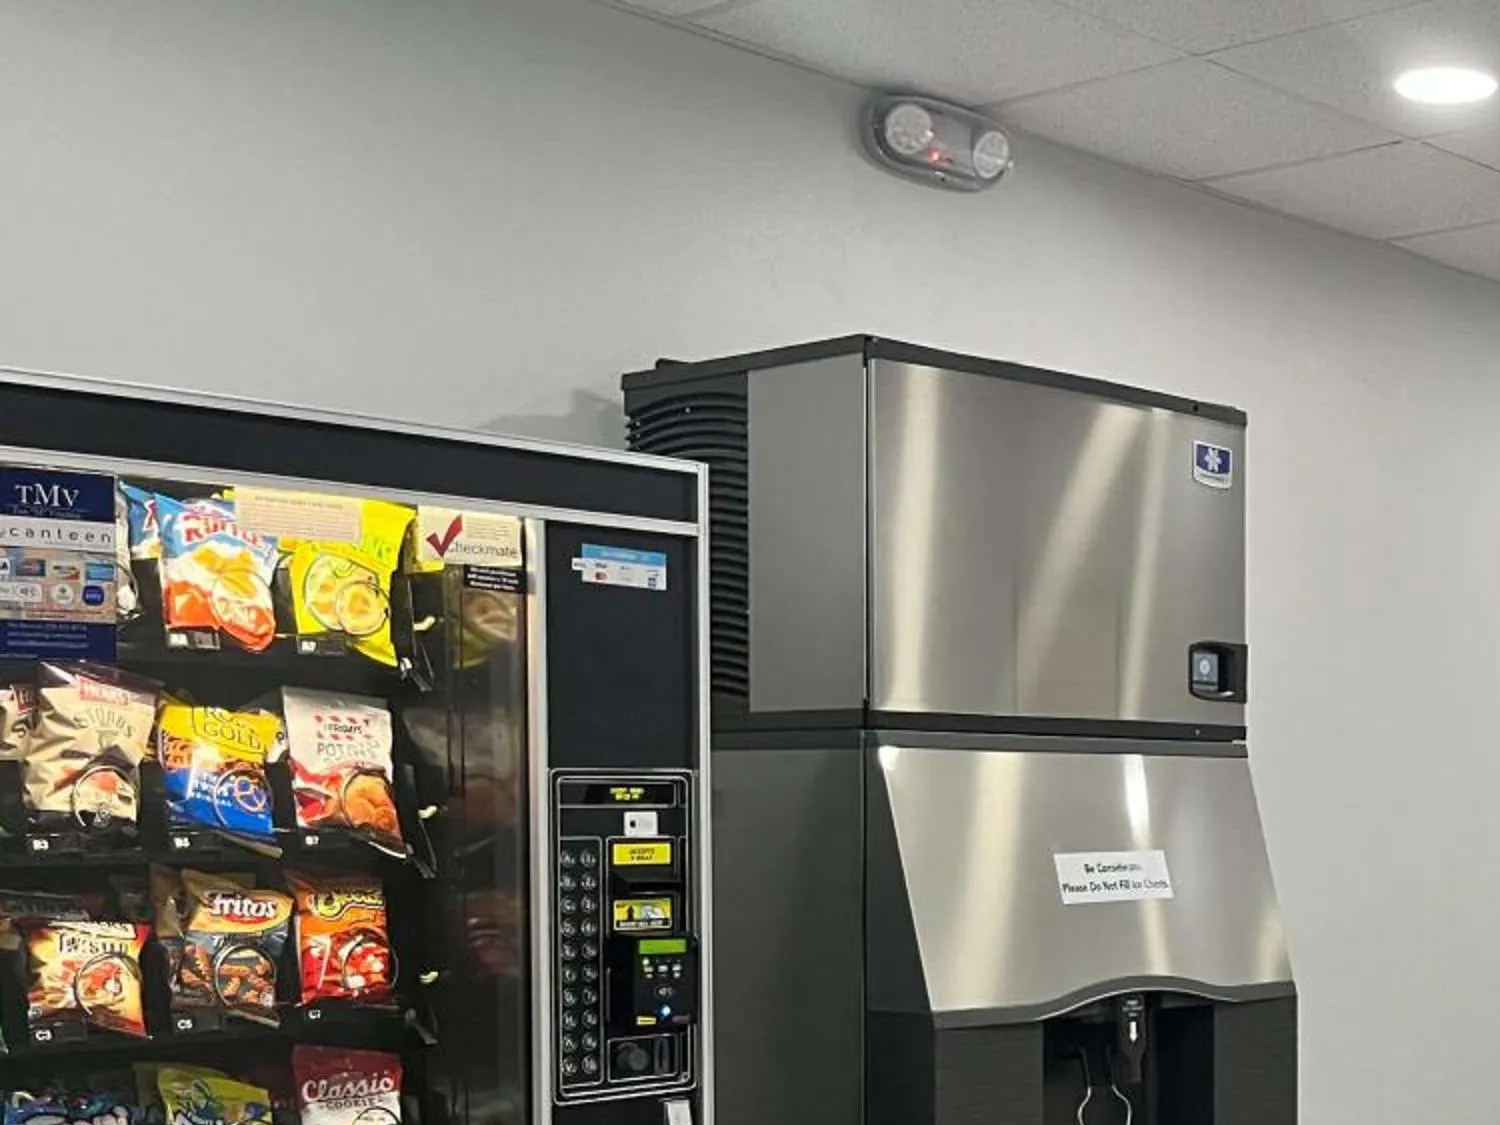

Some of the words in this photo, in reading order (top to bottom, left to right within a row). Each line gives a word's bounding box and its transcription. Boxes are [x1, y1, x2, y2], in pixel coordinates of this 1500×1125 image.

[9, 526, 112, 544] canteen
[202, 722, 262, 751] GOLD
[1062, 883, 1088, 893] Please
[1090, 882, 1103, 892] Do
[1103, 880, 1118, 891] Not
[302, 1068, 395, 1101] Classic
